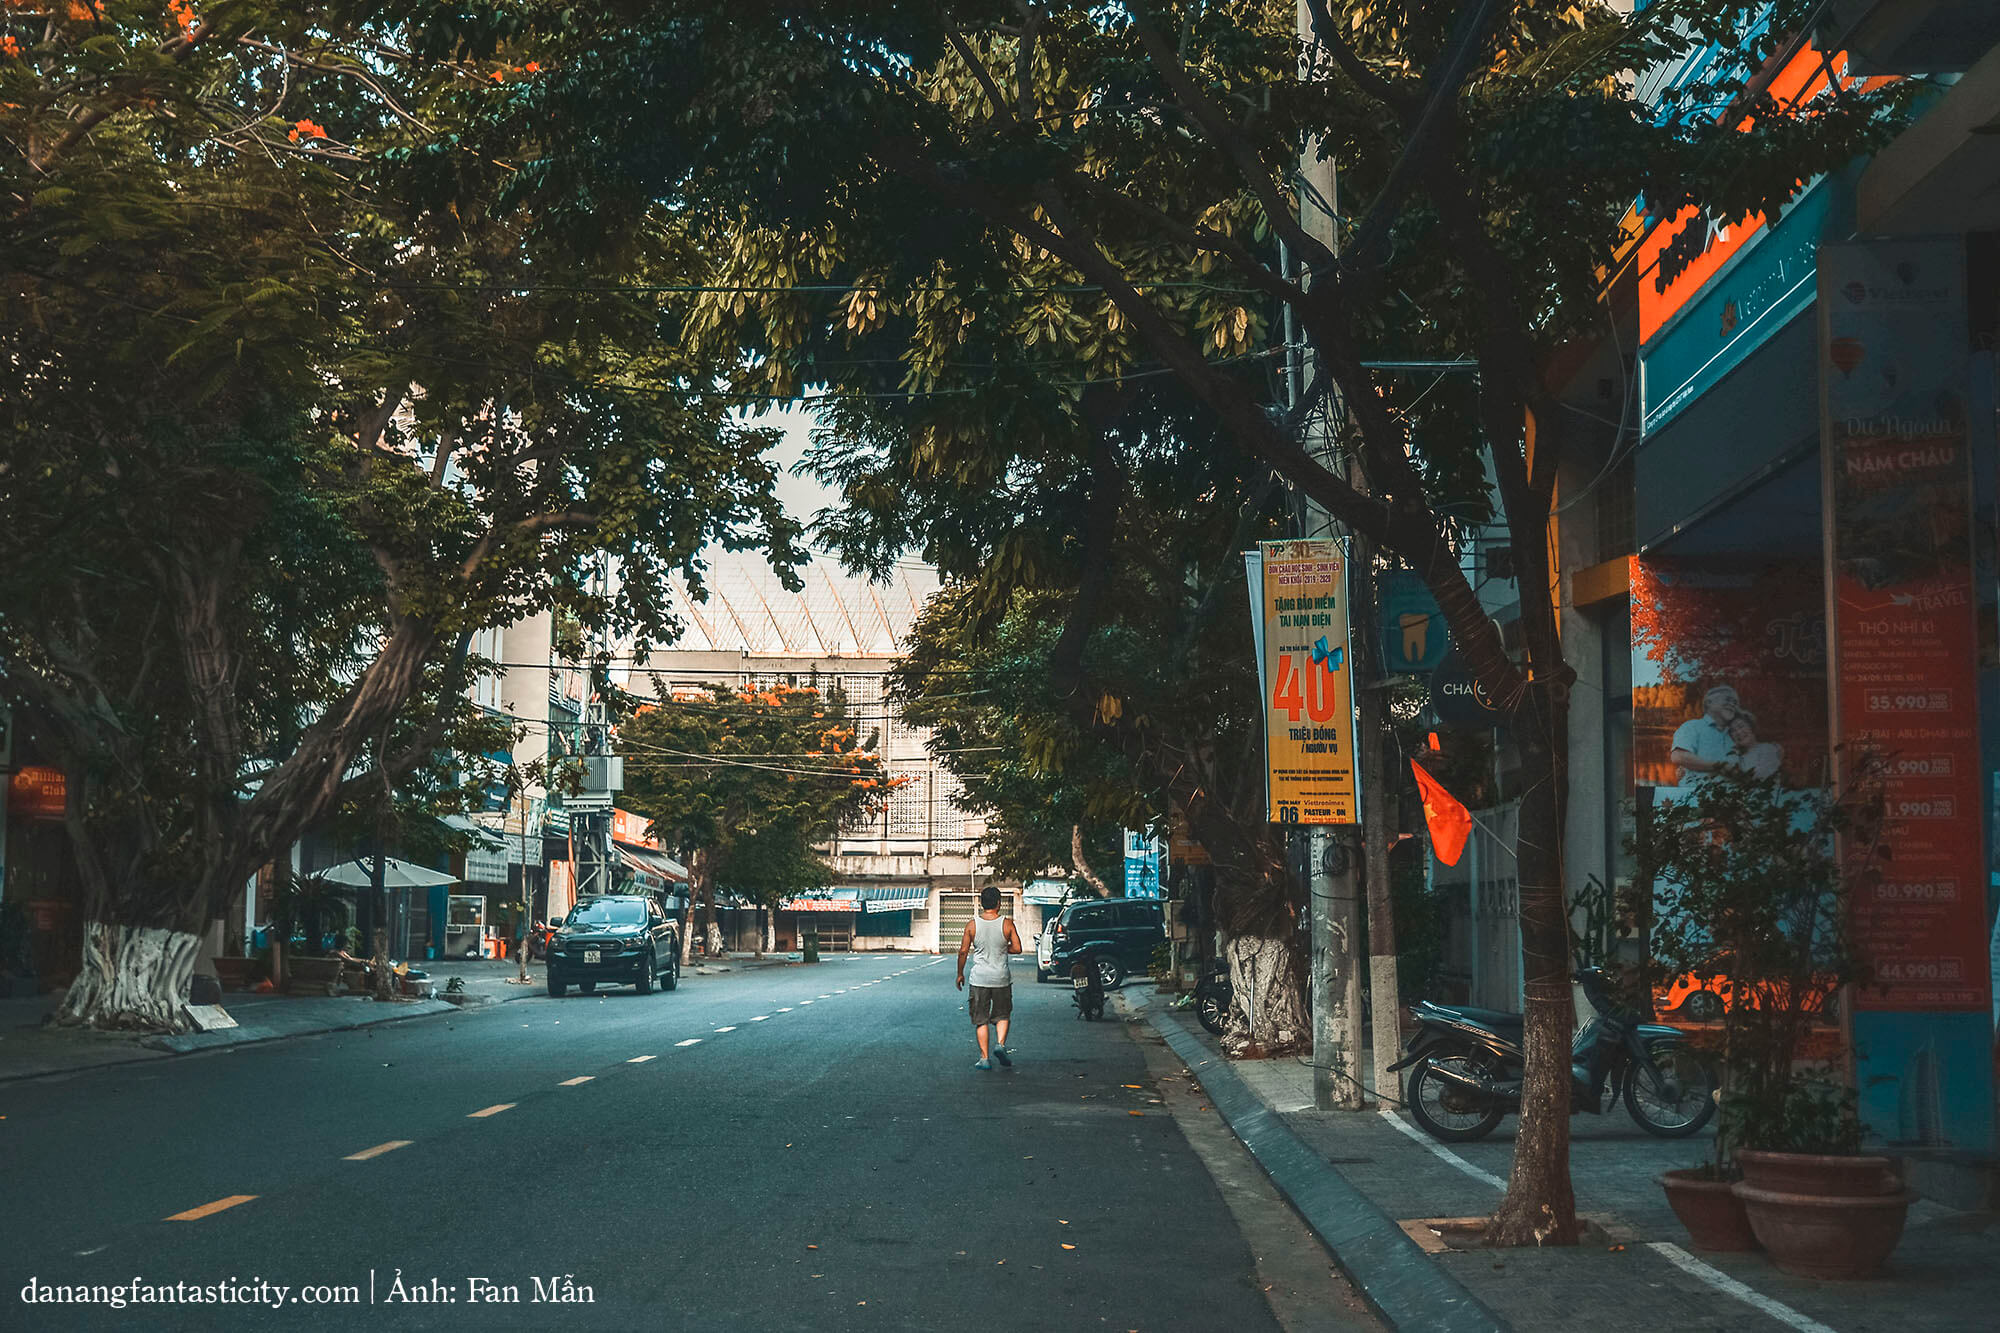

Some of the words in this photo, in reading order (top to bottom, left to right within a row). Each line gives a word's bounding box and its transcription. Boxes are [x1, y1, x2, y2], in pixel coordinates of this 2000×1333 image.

[1847, 416, 1876, 436] Du
[1274, 596, 1296, 614] TẶNG
[1297, 593, 1313, 611] BẢO
[1315, 592, 1337, 610] HIỂM
[1914, 591, 1968, 612] TRAVEL
[1279, 614, 1291, 628] TAI
[1293, 613, 1310, 629] NẠN
[1312, 611, 1331, 629] ĐIỆN
[1273, 654, 1336, 723] 40
[1869, 695, 1928, 710] 35.990
[1289, 726, 1311, 744] TRIỆU
[1280, 806, 1299, 824] 06
[1304, 808, 1331, 816] PASTEUR
[1877, 883, 1934, 899] 50.990
[1879, 963, 1939, 979] 44.990
